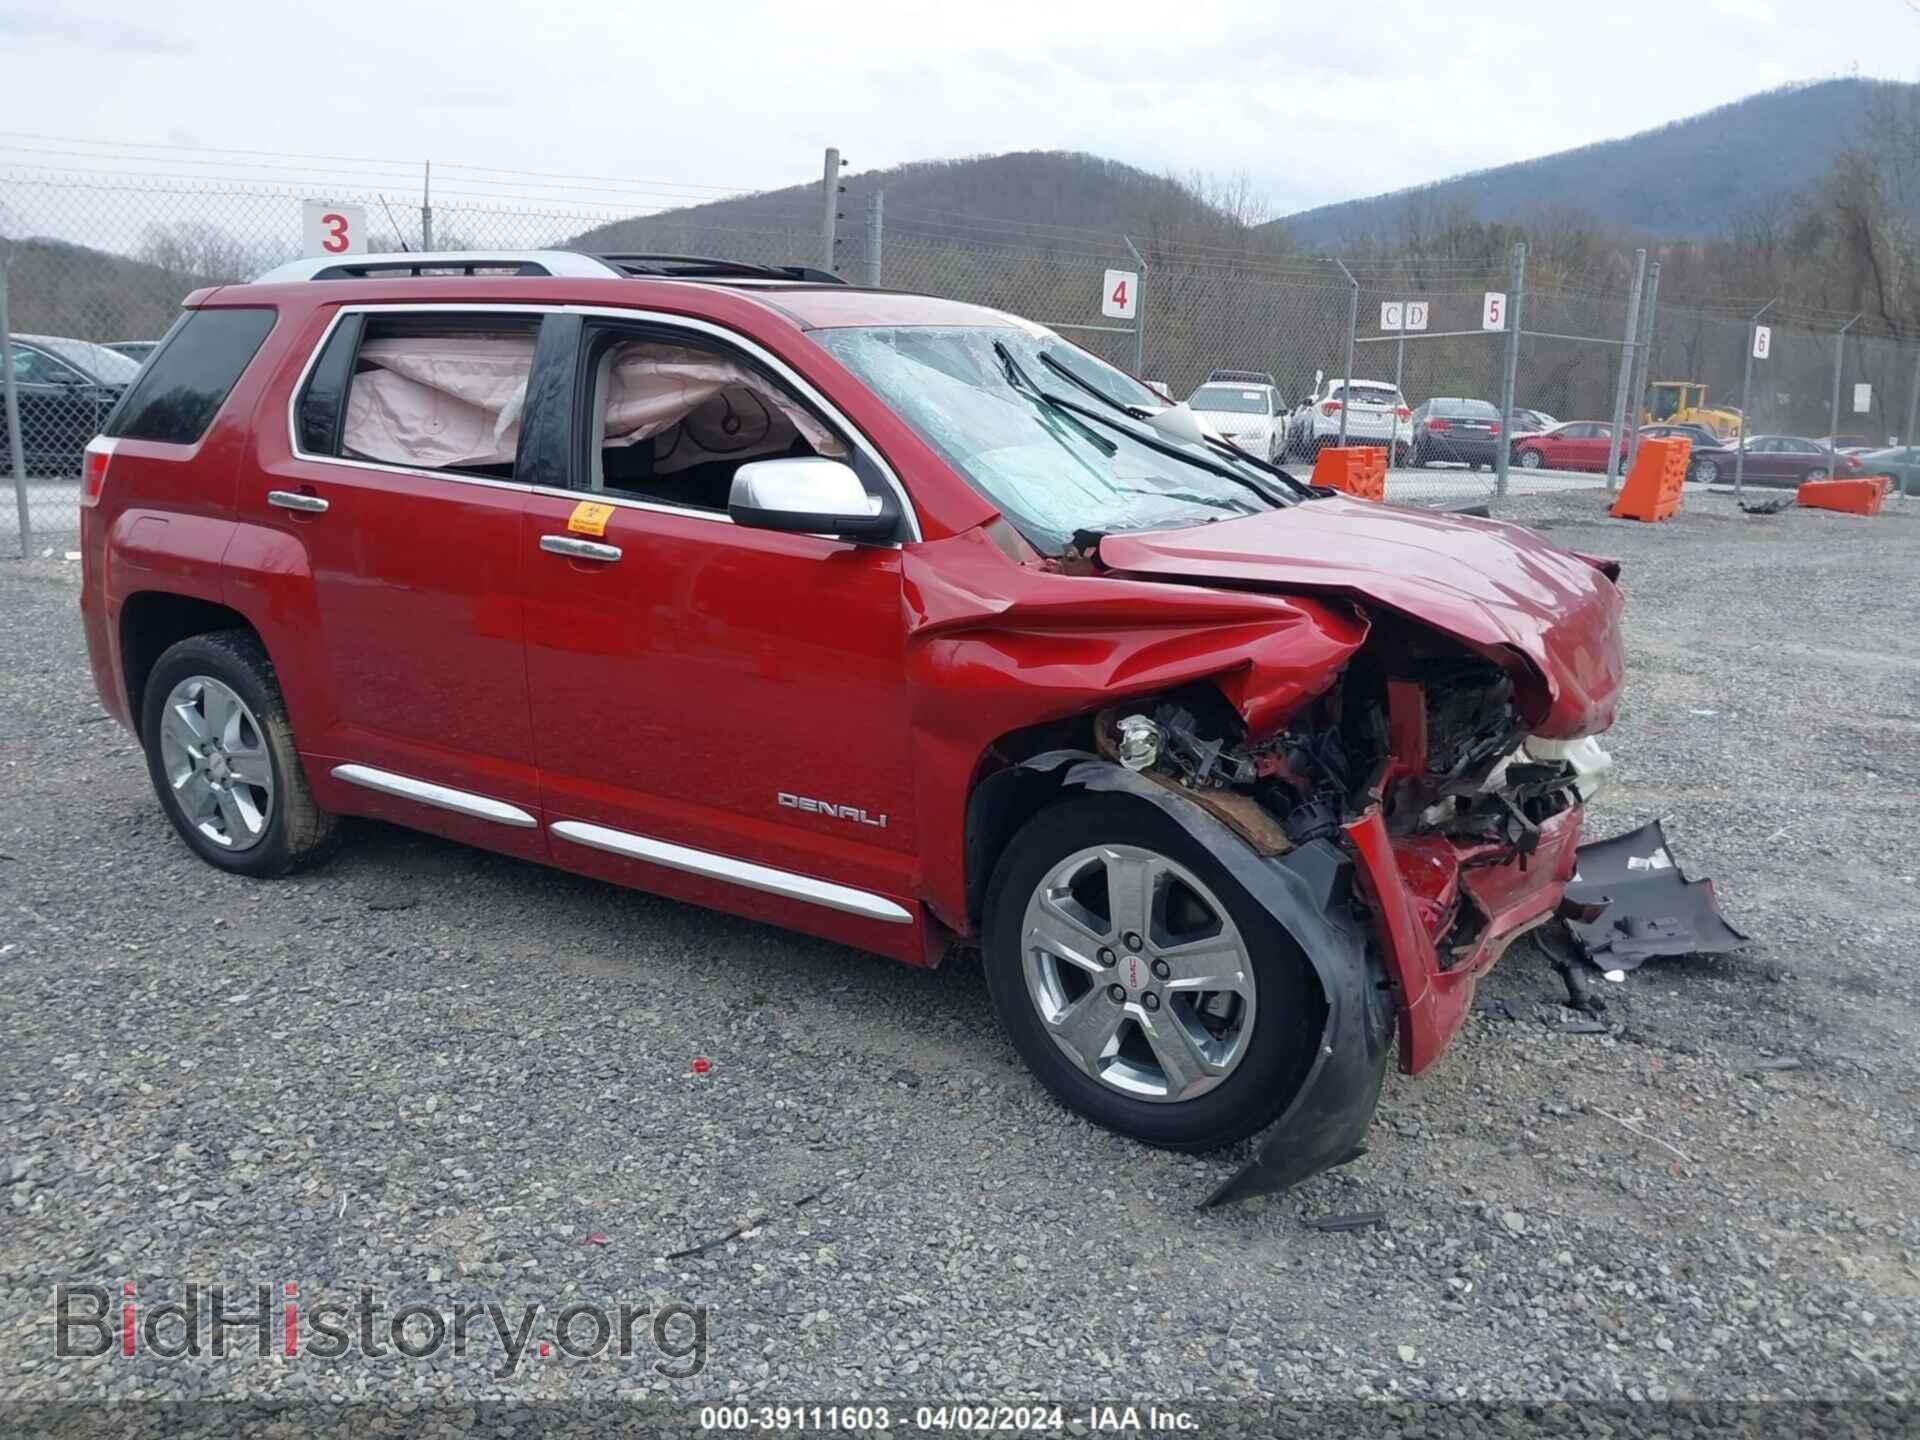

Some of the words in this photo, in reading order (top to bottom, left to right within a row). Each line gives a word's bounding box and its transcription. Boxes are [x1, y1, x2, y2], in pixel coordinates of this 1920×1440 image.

[322, 213, 350, 253] 3
[1112, 280, 1127, 309] 4
[1386, 306, 1399, 325] C
[1410, 306, 1423, 325] D
[1490, 300, 1500, 323] 5
[1758, 333, 1766, 352] 6
[777, 791, 887, 828] DENALI
[1129, 958, 1137, 988] GMC
